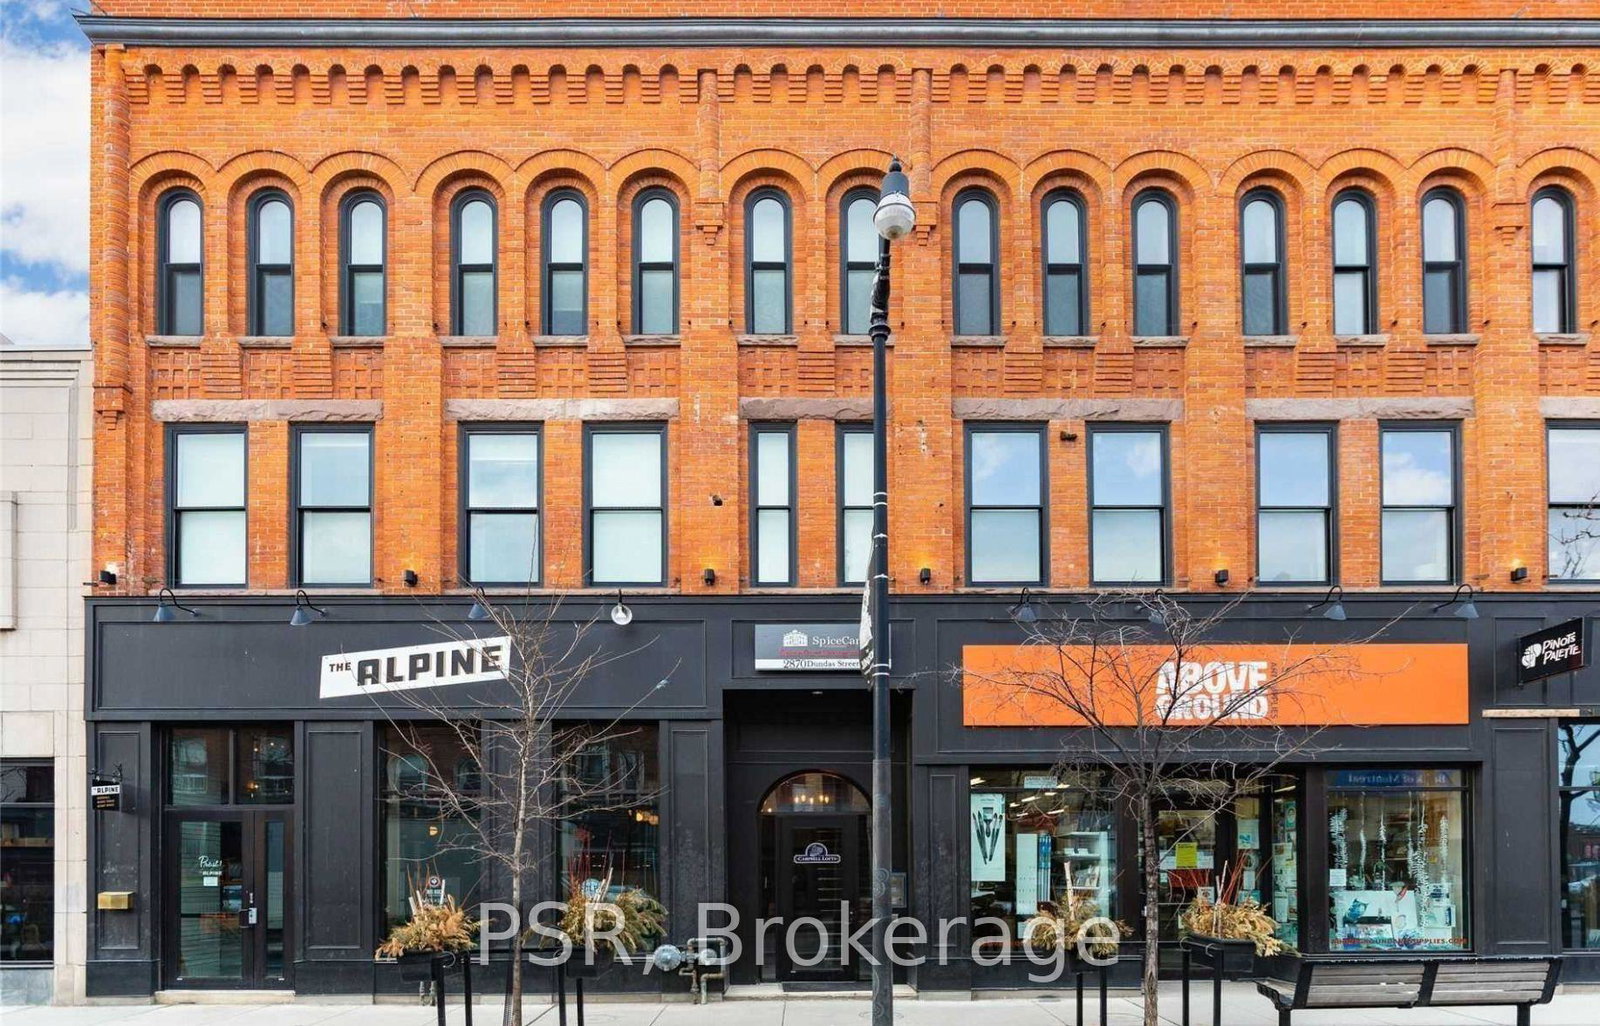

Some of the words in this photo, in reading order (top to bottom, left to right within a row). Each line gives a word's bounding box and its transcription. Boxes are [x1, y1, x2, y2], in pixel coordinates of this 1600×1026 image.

[329, 662, 352, 672] THE
[357, 646, 501, 686] ALPINE
[837, 660, 860, 668] Street
[1155, 661, 1268, 694] ABOVE
[1156, 692, 1268, 719] GROUND
[96, 786, 119, 794] ALPINE
